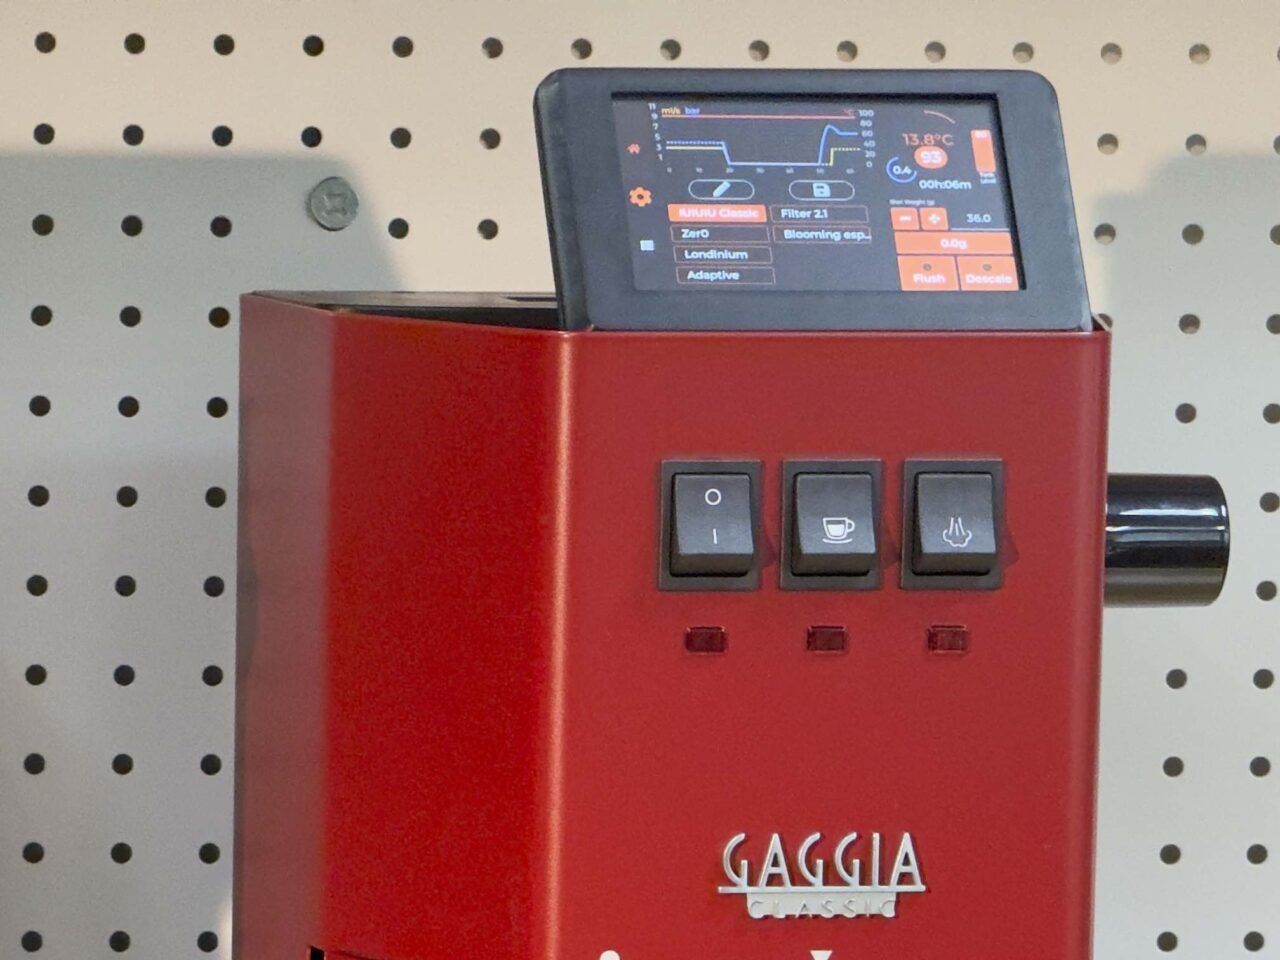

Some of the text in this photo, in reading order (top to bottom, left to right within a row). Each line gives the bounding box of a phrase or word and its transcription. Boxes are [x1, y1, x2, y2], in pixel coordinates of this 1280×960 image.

[718, 209, 759, 218] Classic
[781, 209, 828, 219] Filter 2.1
[783, 229, 842, 241] Blooming
[684, 250, 748, 260] Londinium
[687, 270, 740, 282] Adaptive
[913, 273, 946, 284] Flush
[965, 273, 1013, 284] Descale
[719, 832, 926, 893] GAGGIA
[748, 899, 896, 919] CLASSIC
